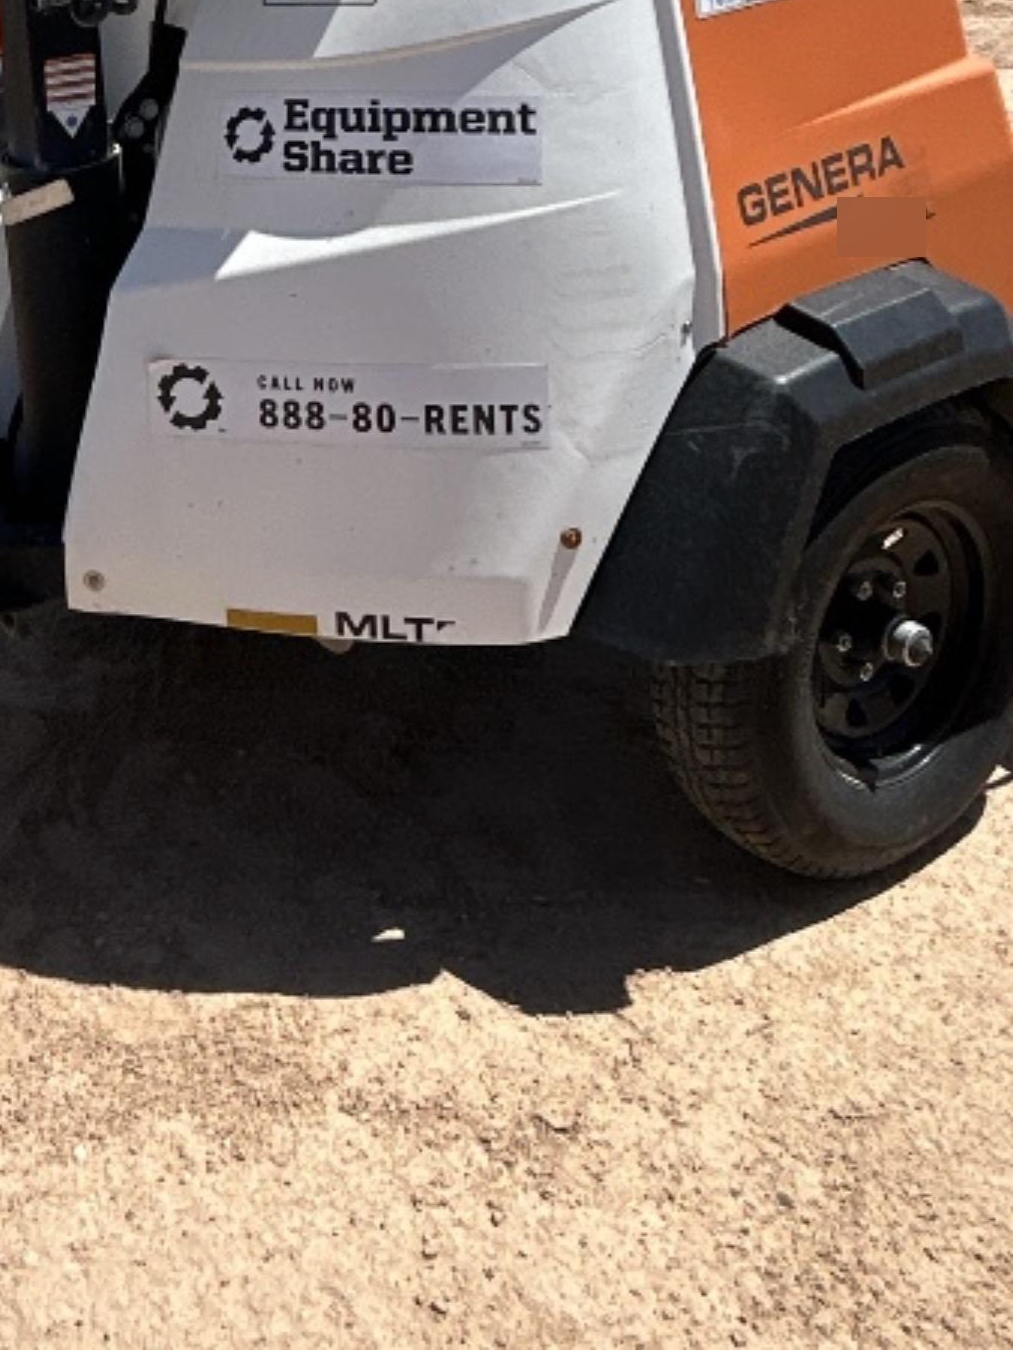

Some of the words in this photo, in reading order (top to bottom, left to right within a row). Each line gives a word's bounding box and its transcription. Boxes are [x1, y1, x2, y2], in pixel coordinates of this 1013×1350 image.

[283, 98, 538, 141] Equipment
[283, 140, 414, 175] Share
[256, 374, 304, 391] CALL
[312, 376, 355, 394] NOW
[259, 398, 543, 435] 888-80-RENTS
